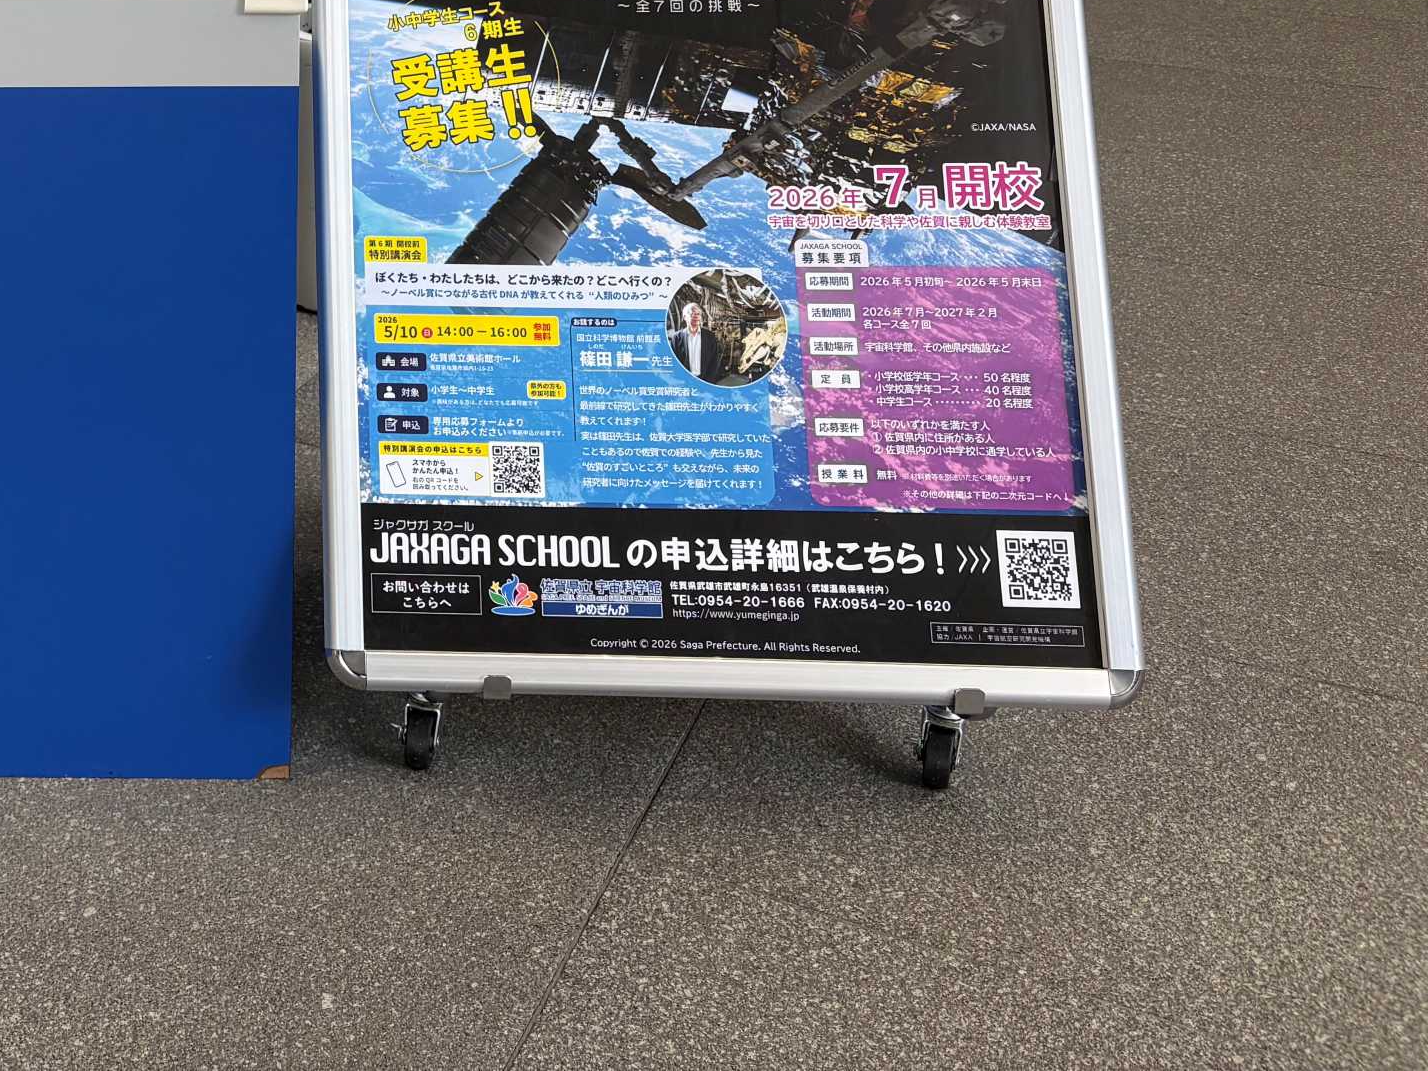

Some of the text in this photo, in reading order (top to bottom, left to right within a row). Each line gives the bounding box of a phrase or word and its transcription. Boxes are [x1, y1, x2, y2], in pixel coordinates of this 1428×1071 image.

[388, 1, 505, 32] 小中学生コース
[464, 17, 524, 41] 6期生
[391, 43, 532, 102] 受講生
[768, 214, 1052, 230] 宇宙を切り口とした科学や佐賀に親しむ体験教室
[369, 249, 422, 261] 特別講演会
[801, 252, 861, 264] 募集要項
[809, 276, 849, 287] 応募期間
[811, 308, 852, 319] 活動期間
[533, 322, 551, 332] 参加
[573, 319, 615, 327] お話するのは
[384, 324, 418, 340] 5/10
[437, 326, 474, 337] 14:00
[490, 327, 527, 338] 16:00
[813, 341, 854, 352] 活動場所
[400, 357, 419, 367] 会場
[651, 356, 672, 367] 先生
[401, 387, 420, 398] 対象
[402, 420, 421, 430] 申込
[433, 416, 524, 427] 専用応募フォームより
[818, 422, 860, 433] 応募要件
[871, 419, 991, 431] 以下のいずれかを満たす人
[383, 444, 482, 454] 特別講演会の申込はこちら
[821, 469, 864, 480] 授業料
[876, 470, 897, 481] 無料
[373, 519, 475, 532] ジャクサガ スクール
[370, 532, 491, 565] JAXAGA
[498, 534, 620, 568] SCHOOL
[383, 581, 470, 594] お問い合わせは
[403, 596, 452, 609] こちらへ
[672, 595, 805, 608] TEL:0954-20-1666
[814, 598, 951, 612] FAX:0954-20-1620
[575, 604, 629, 615] ゆめぎんが
[672, 608, 800, 621] https://www.yumeginga.jp
[591, 638, 636, 650] Copyright
[651, 639, 677, 649] 2026
[680, 640, 704, 651] Saga
[706, 640, 761, 651] Prefecture.
[764, 642, 777, 651] All
[779, 642, 810, 654] Rights
[812, 644, 861, 654] Reserved.
